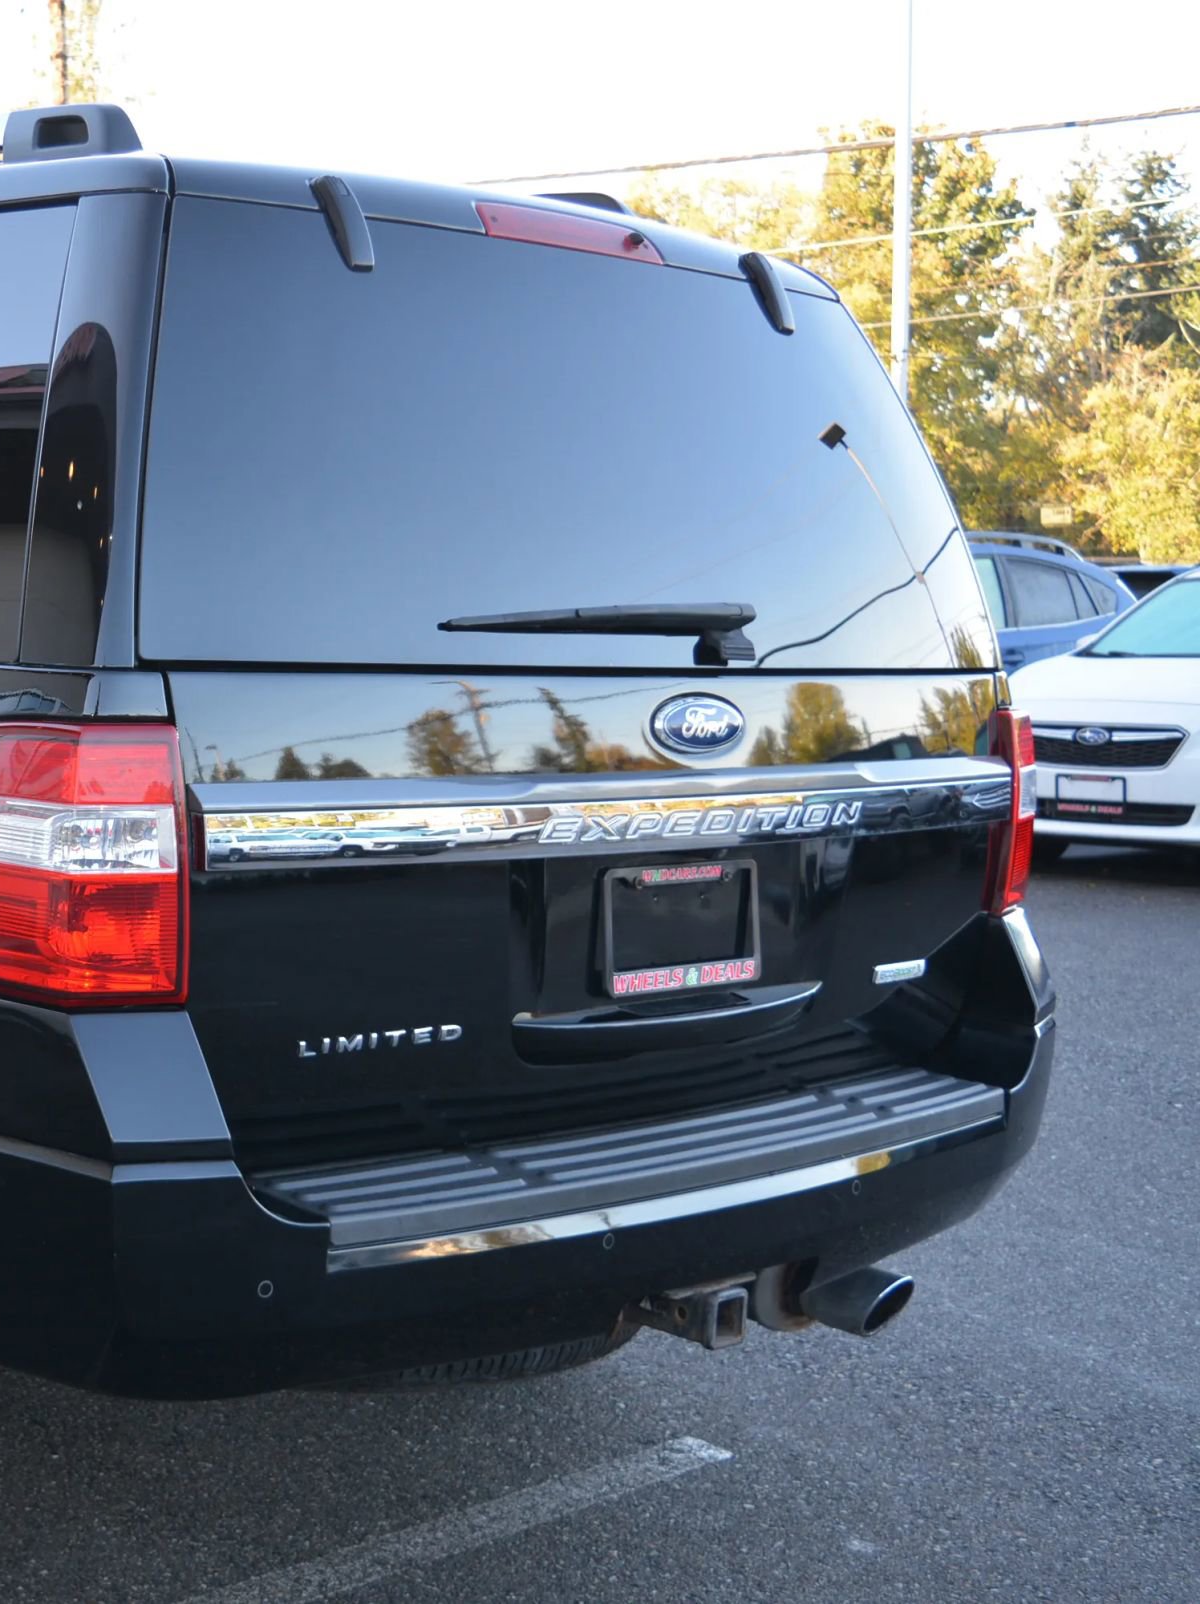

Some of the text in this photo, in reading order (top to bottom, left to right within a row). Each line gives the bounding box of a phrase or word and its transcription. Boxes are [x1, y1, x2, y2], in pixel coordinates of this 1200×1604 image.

[681, 706, 730, 739] Ford
[538, 801, 864, 844] EXPEDITION
[613, 960, 755, 994] WHEELS & DEALS
[297, 1024, 463, 1057] LIMITED
